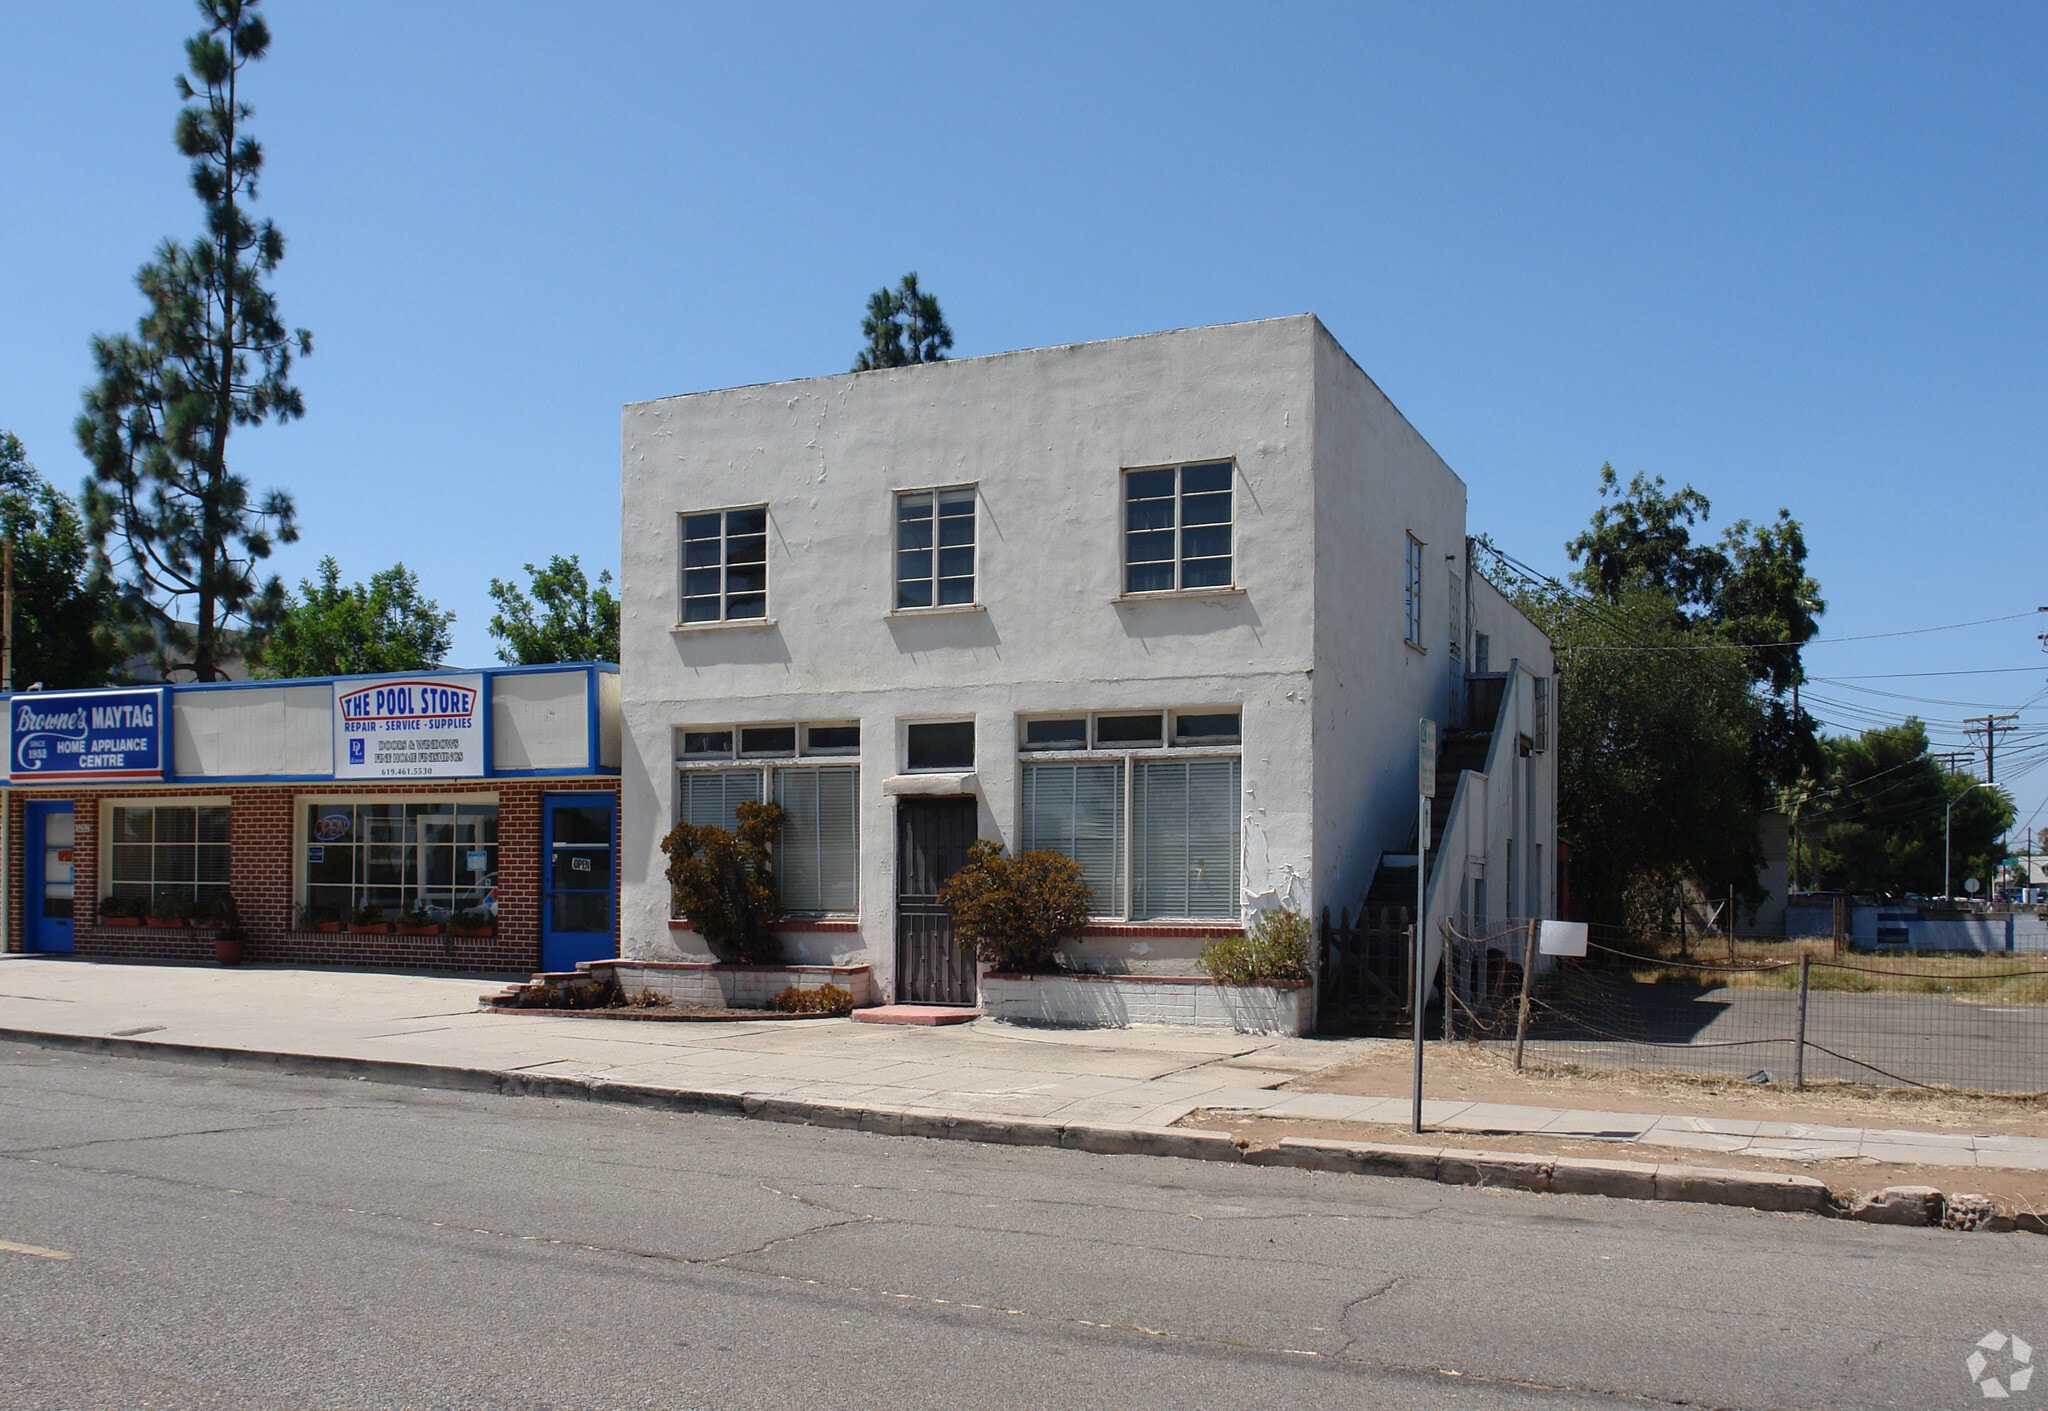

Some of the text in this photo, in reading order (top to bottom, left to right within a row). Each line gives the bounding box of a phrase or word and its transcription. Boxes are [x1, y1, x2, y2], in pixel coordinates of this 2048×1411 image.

[344, 687, 470, 717] THE POOL STORE
[16, 704, 153, 732] Browne's MAYTAG
[344, 720, 376, 732] REPAIR
[385, 719, 421, 731] SERVICE
[429, 717, 472, 729] SUPPLIES
[57, 738, 147, 753] HOME APPLIANCE
[378, 739, 459, 751] DOORS & WINDOWS
[79, 753, 125, 768] CENTRE
[374, 753, 392, 764] FINE
[393, 752, 418, 764] HOME
[381, 767, 433, 776] 619.461.5530
[314, 819, 347, 836] OPEN
[573, 859, 590, 870] OPEN
